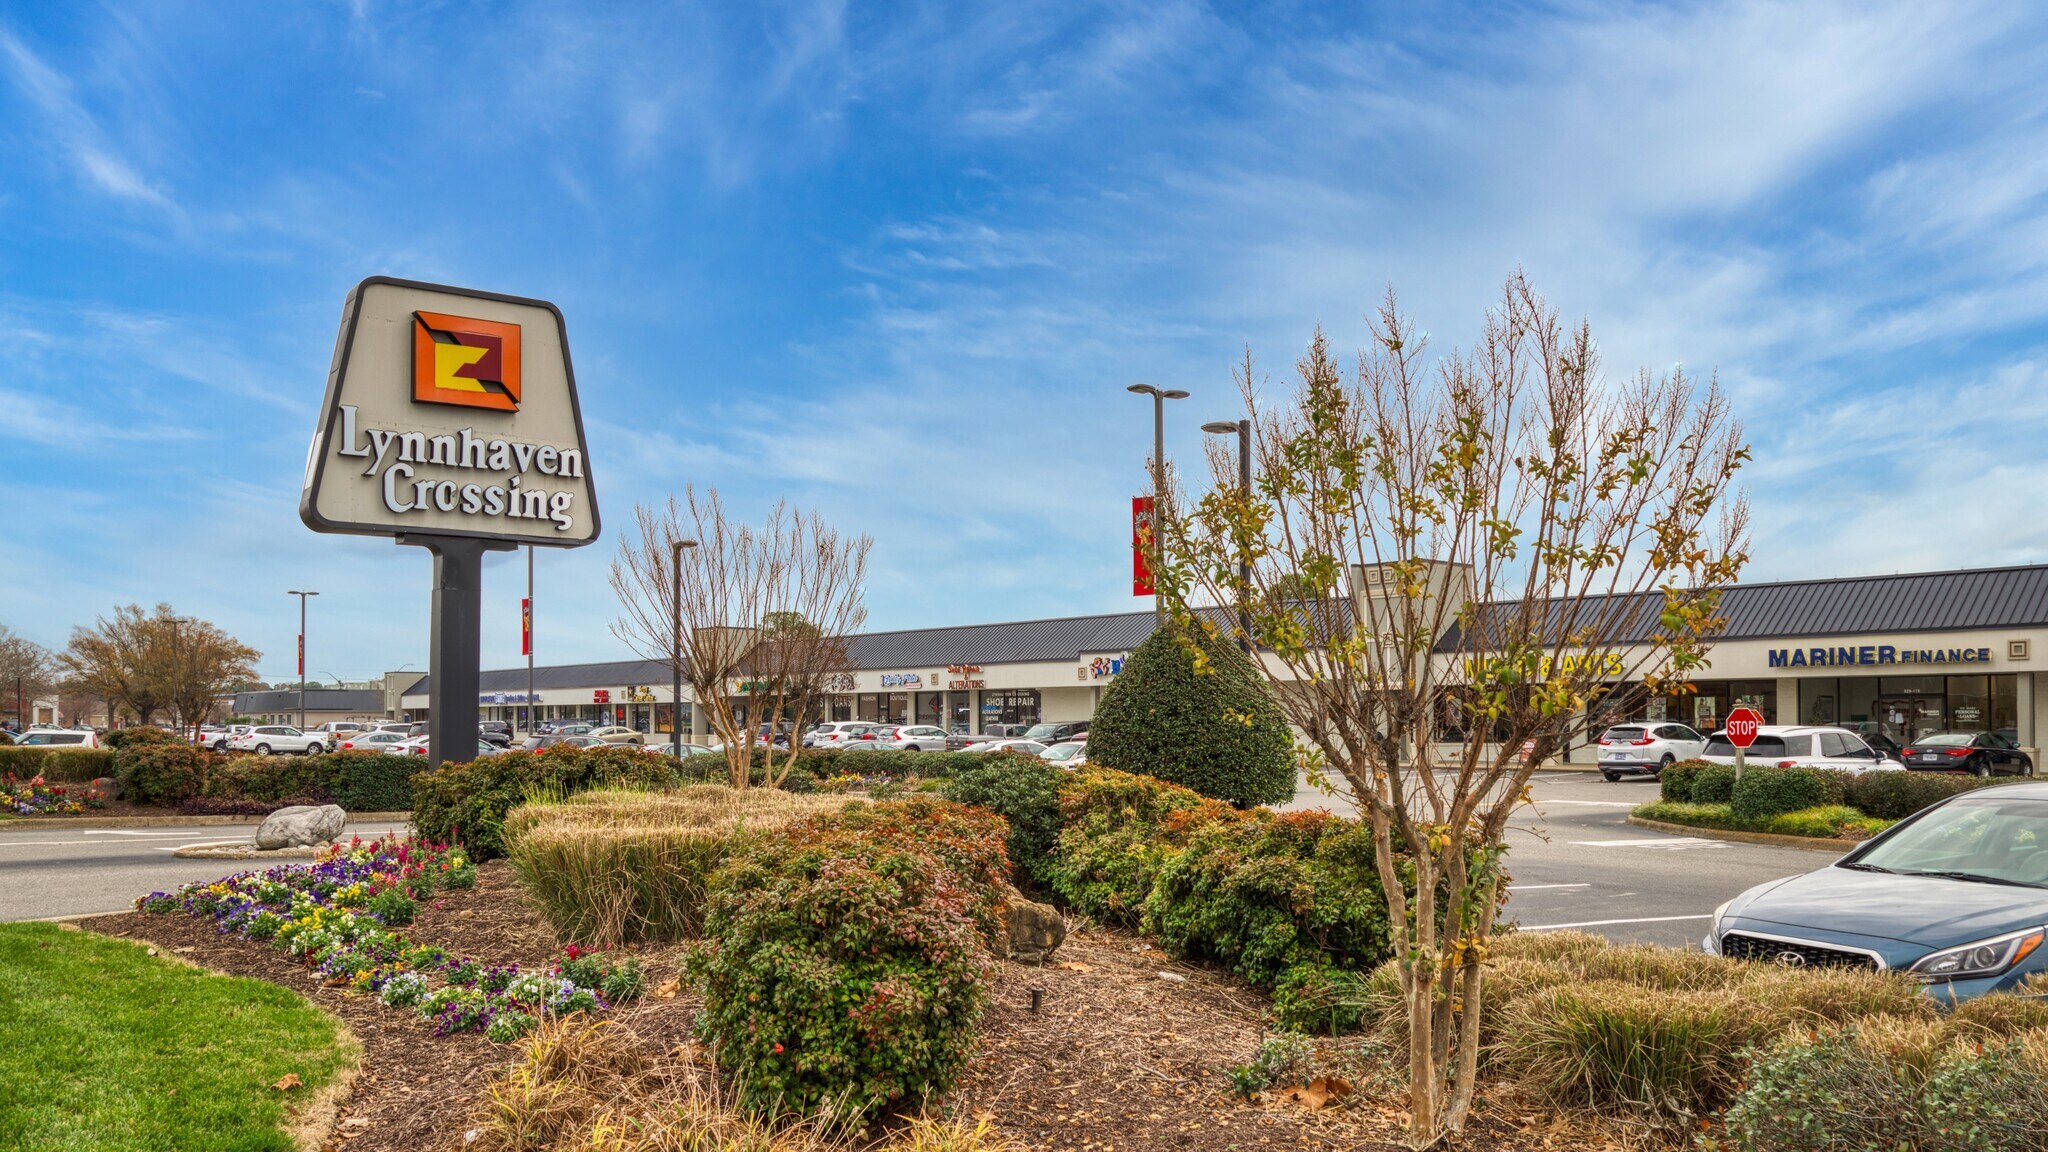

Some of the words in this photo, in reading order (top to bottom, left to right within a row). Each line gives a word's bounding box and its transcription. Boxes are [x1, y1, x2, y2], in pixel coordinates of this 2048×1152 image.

[339, 405, 584, 477] Lynnhaven
[383, 463, 575, 531] Crossing
[1540, 655, 1551, 676] &
[1768, 645, 1896, 667] MARINER
[1901, 647, 1991, 663] FINANCE
[948, 680, 986, 690] ALTERATIONS
[986, 697, 1004, 706] SHOE
[1008, 697, 1035, 706] REPAIR
[1729, 721, 1756, 736] STOP
